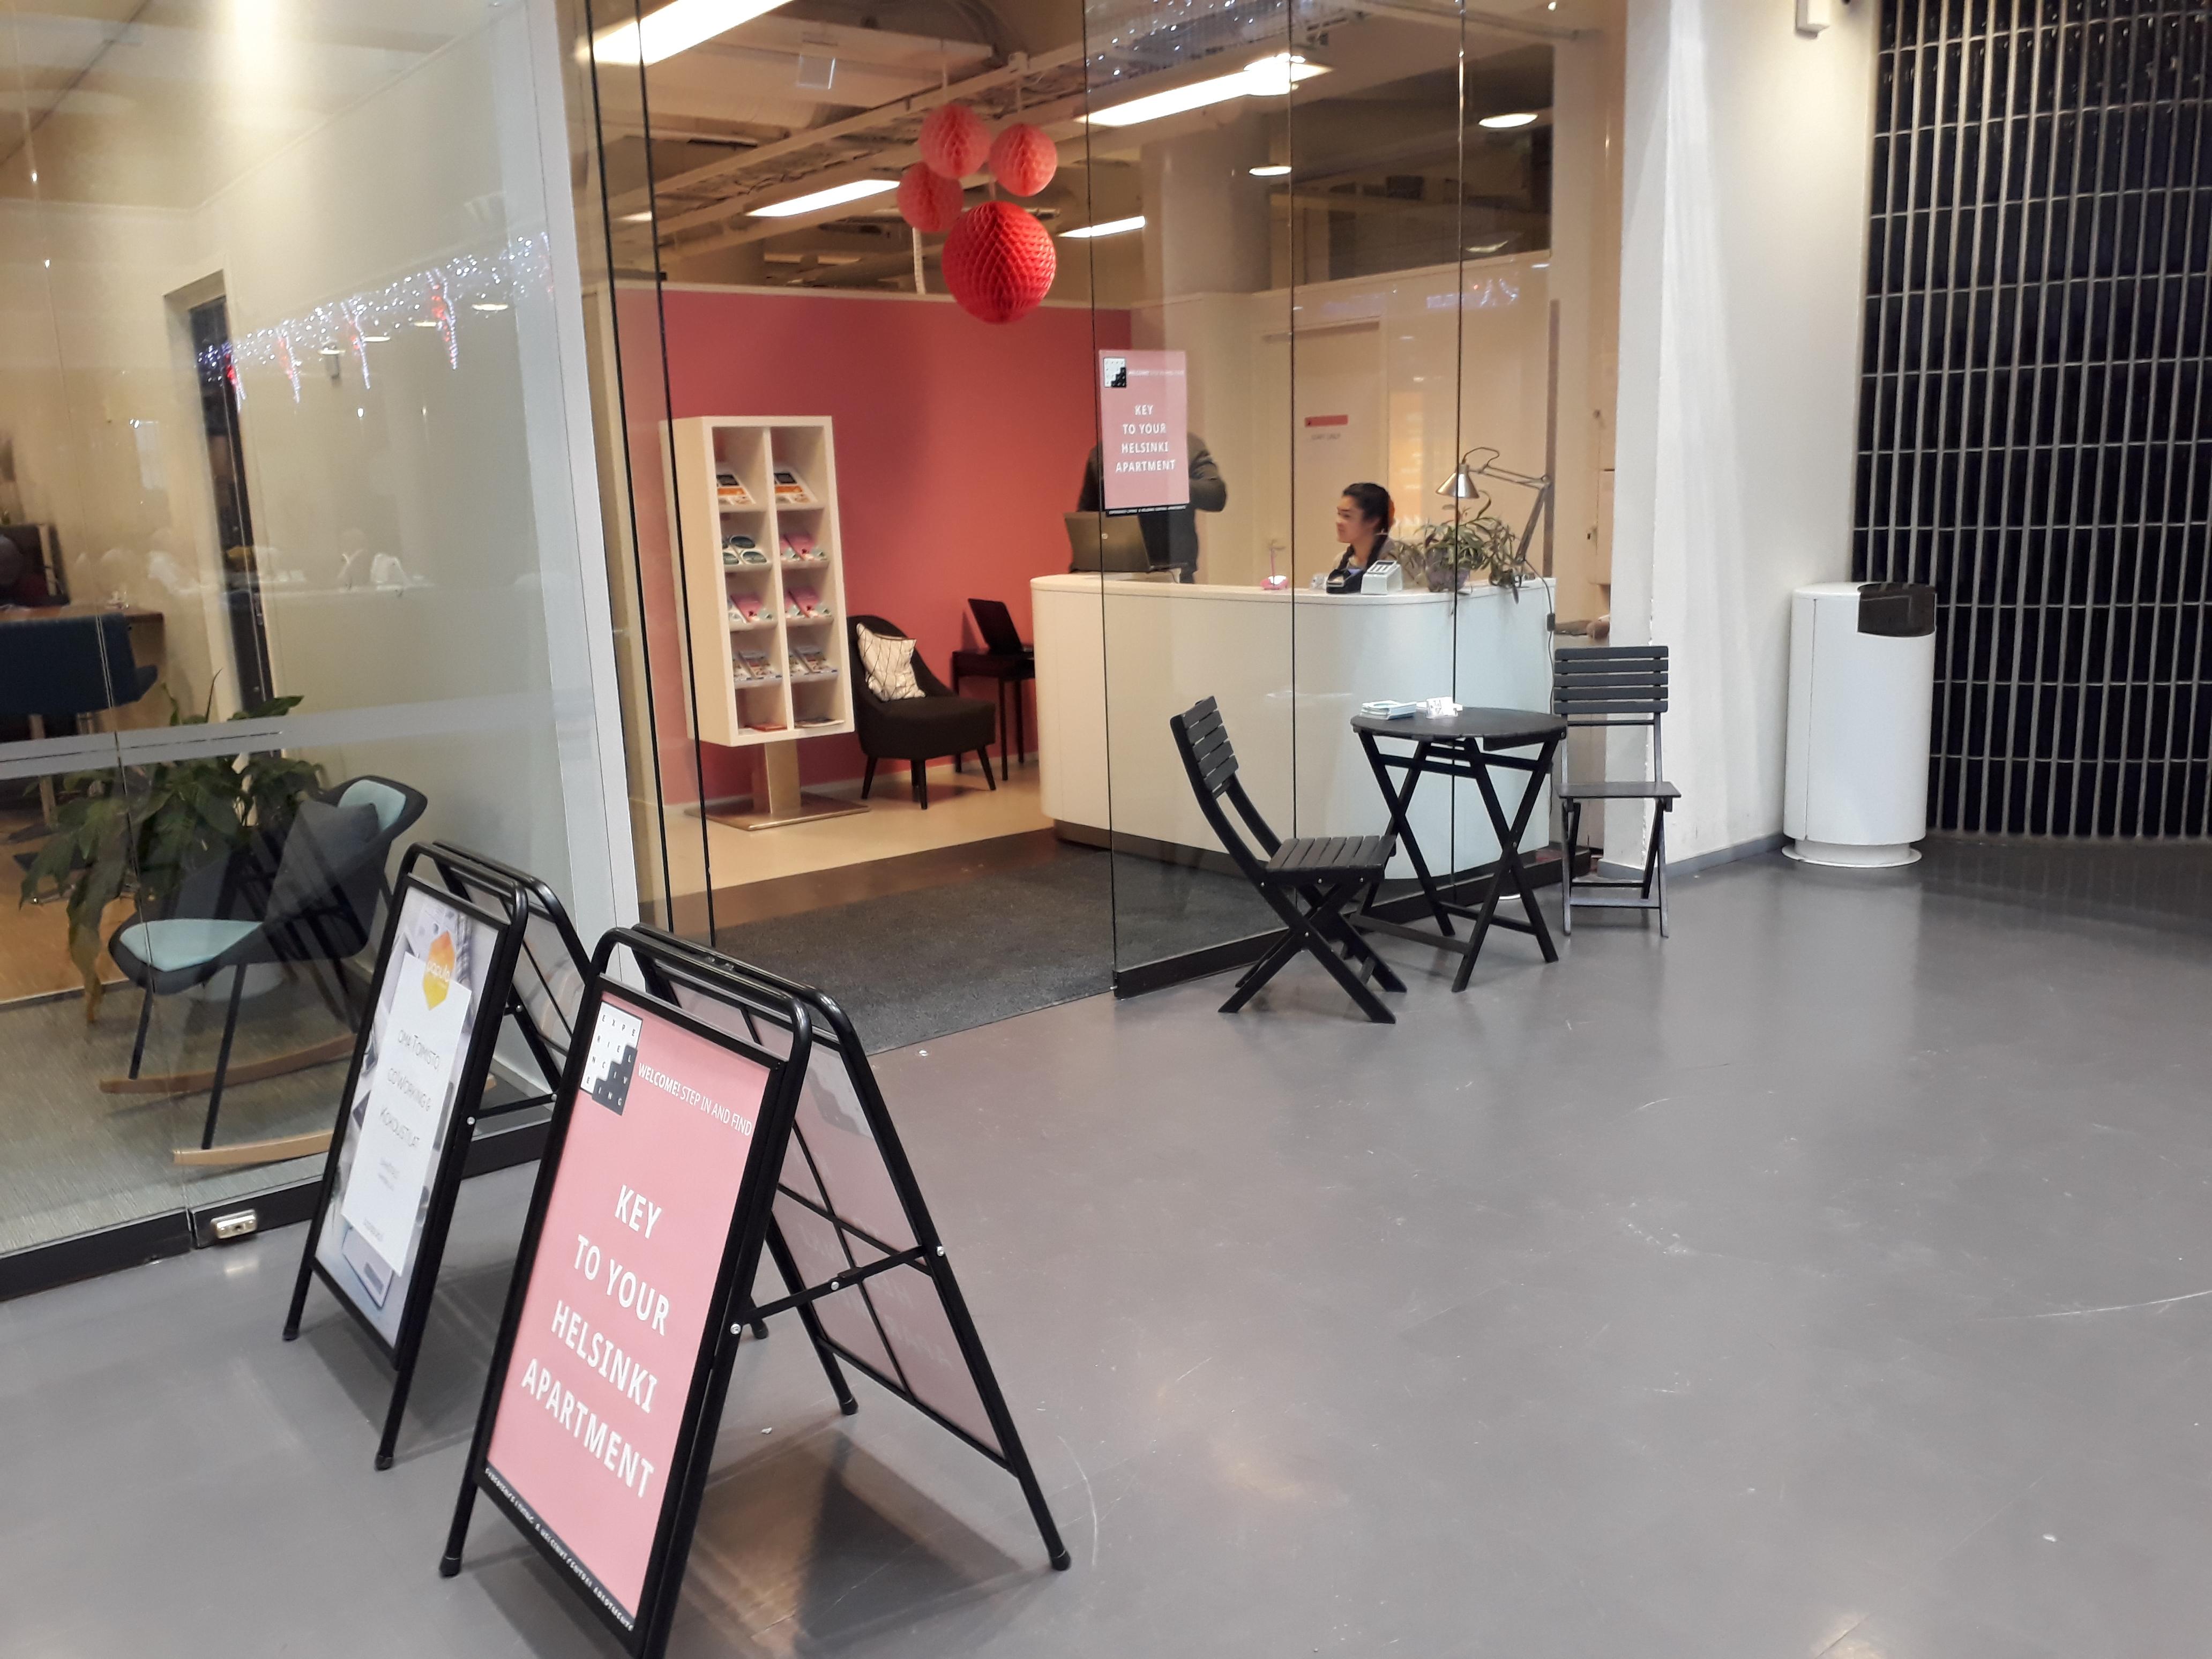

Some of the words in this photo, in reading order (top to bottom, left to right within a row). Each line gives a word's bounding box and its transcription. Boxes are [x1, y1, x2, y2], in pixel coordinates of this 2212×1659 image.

[1123, 423, 1135, 435] TO
[1139, 423, 1167, 435] YOUR
[1134, 405, 1153, 415] KEY
[1116, 459, 1175, 472] APARTMENT
[1122, 441, 1168, 454] HELSINKI
[638, 1063, 681, 1096] WELCOME!
[680, 1086, 701, 1107] STEP
[700, 1096, 712, 1114] IN
[711, 1103, 730, 1124] AND
[731, 1112, 752, 1136] FIND
[615, 1184, 662, 1239] KEY
[574, 1234, 601, 1281] TO
[606, 1259, 670, 1336] YOUR
[551, 1300, 658, 1414] HELSINKI
[521, 1358, 655, 1498] APARTMENT
